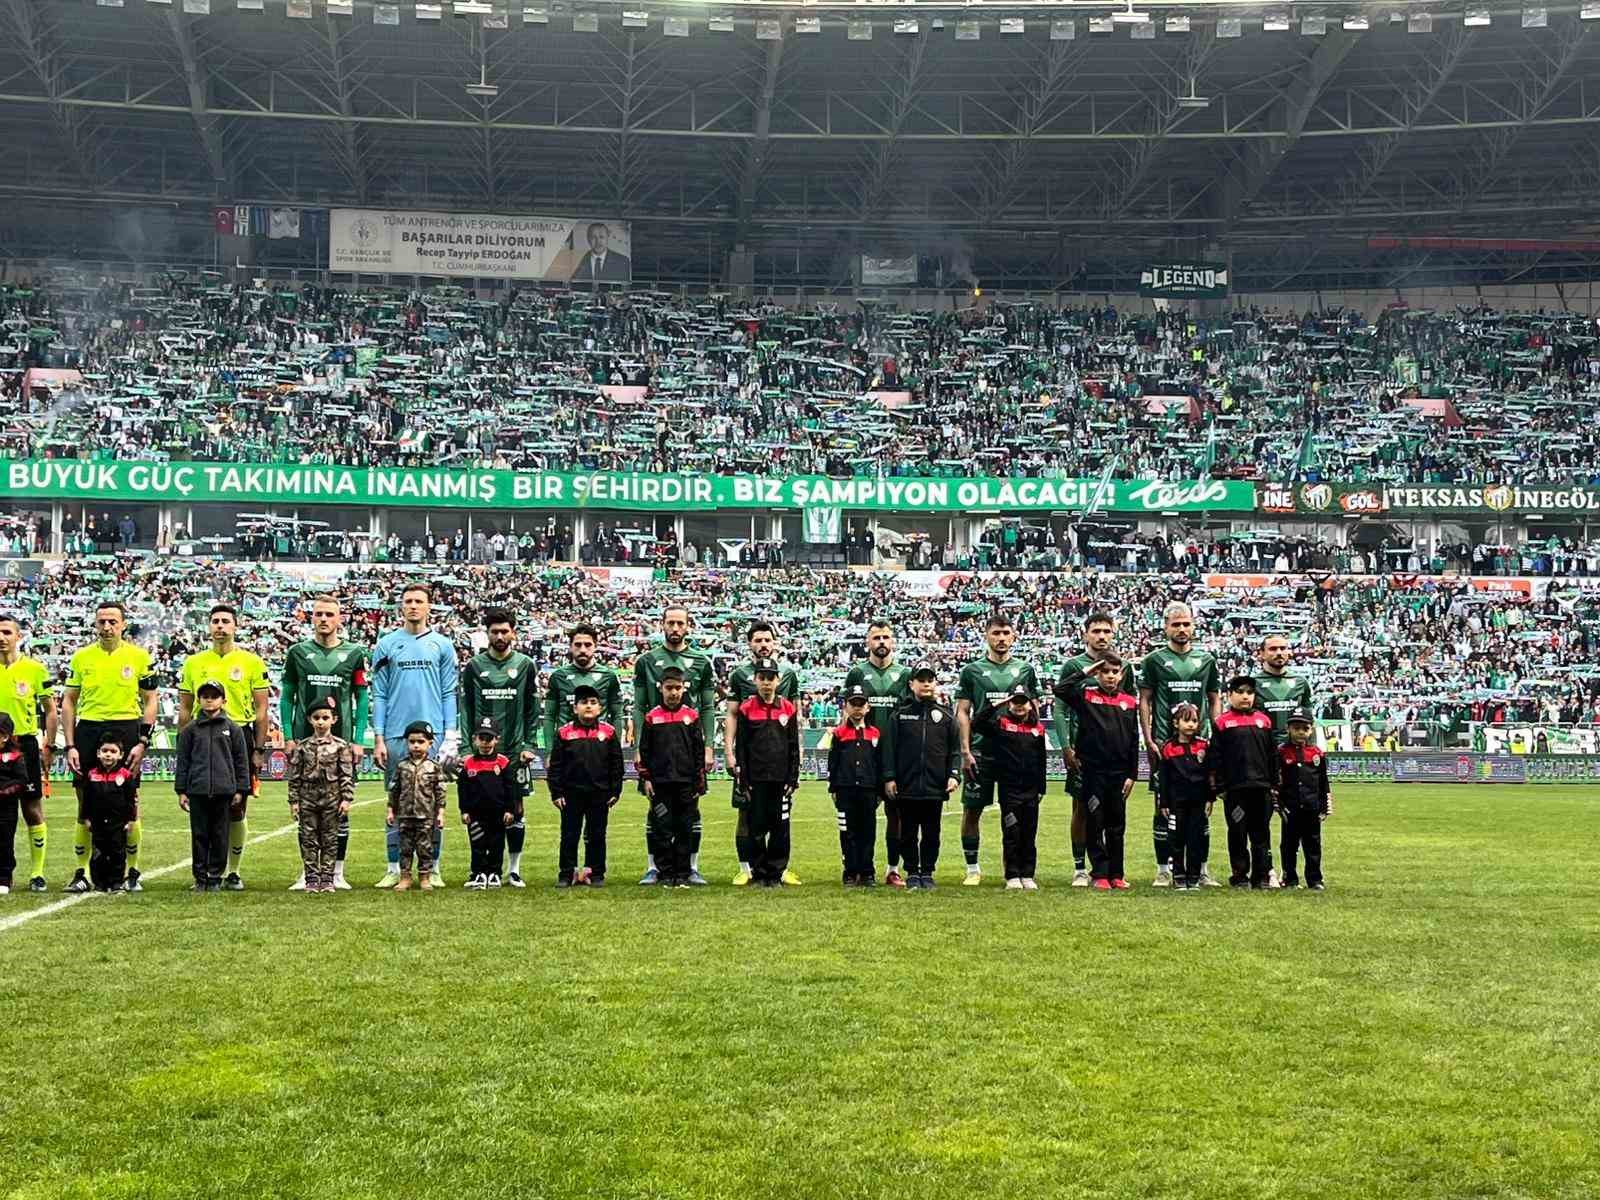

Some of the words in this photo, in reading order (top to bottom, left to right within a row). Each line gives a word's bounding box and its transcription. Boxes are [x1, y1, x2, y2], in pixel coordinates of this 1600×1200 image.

[383, 215, 406, 226] TÜM
[408, 217, 462, 229] ANTRENÖR
[479, 220, 566, 233] SPORCULARIMIZA
[402, 231, 473, 246] BAŞARILAR
[475, 234, 546, 248] DİLİYORUM
[416, 247, 446, 258] Recep
[448, 249, 480, 261] Tayyip
[482, 248, 531, 260] ERDOĞAN
[1152, 268, 1215, 289] LEGEND
[9, 459, 118, 489] BÜYÜK
[128, 461, 195, 496] GÜÇ
[204, 467, 356, 495] TAKIMINA
[367, 467, 496, 502] İNANMIŞ
[792, 477, 947, 508] ŞAMPİYON
[958, 478, 1116, 506] OLACAĞIZ!
[1389, 488, 1482, 507] TEKSAS
[1513, 487, 1599, 509] İNEGÖL
